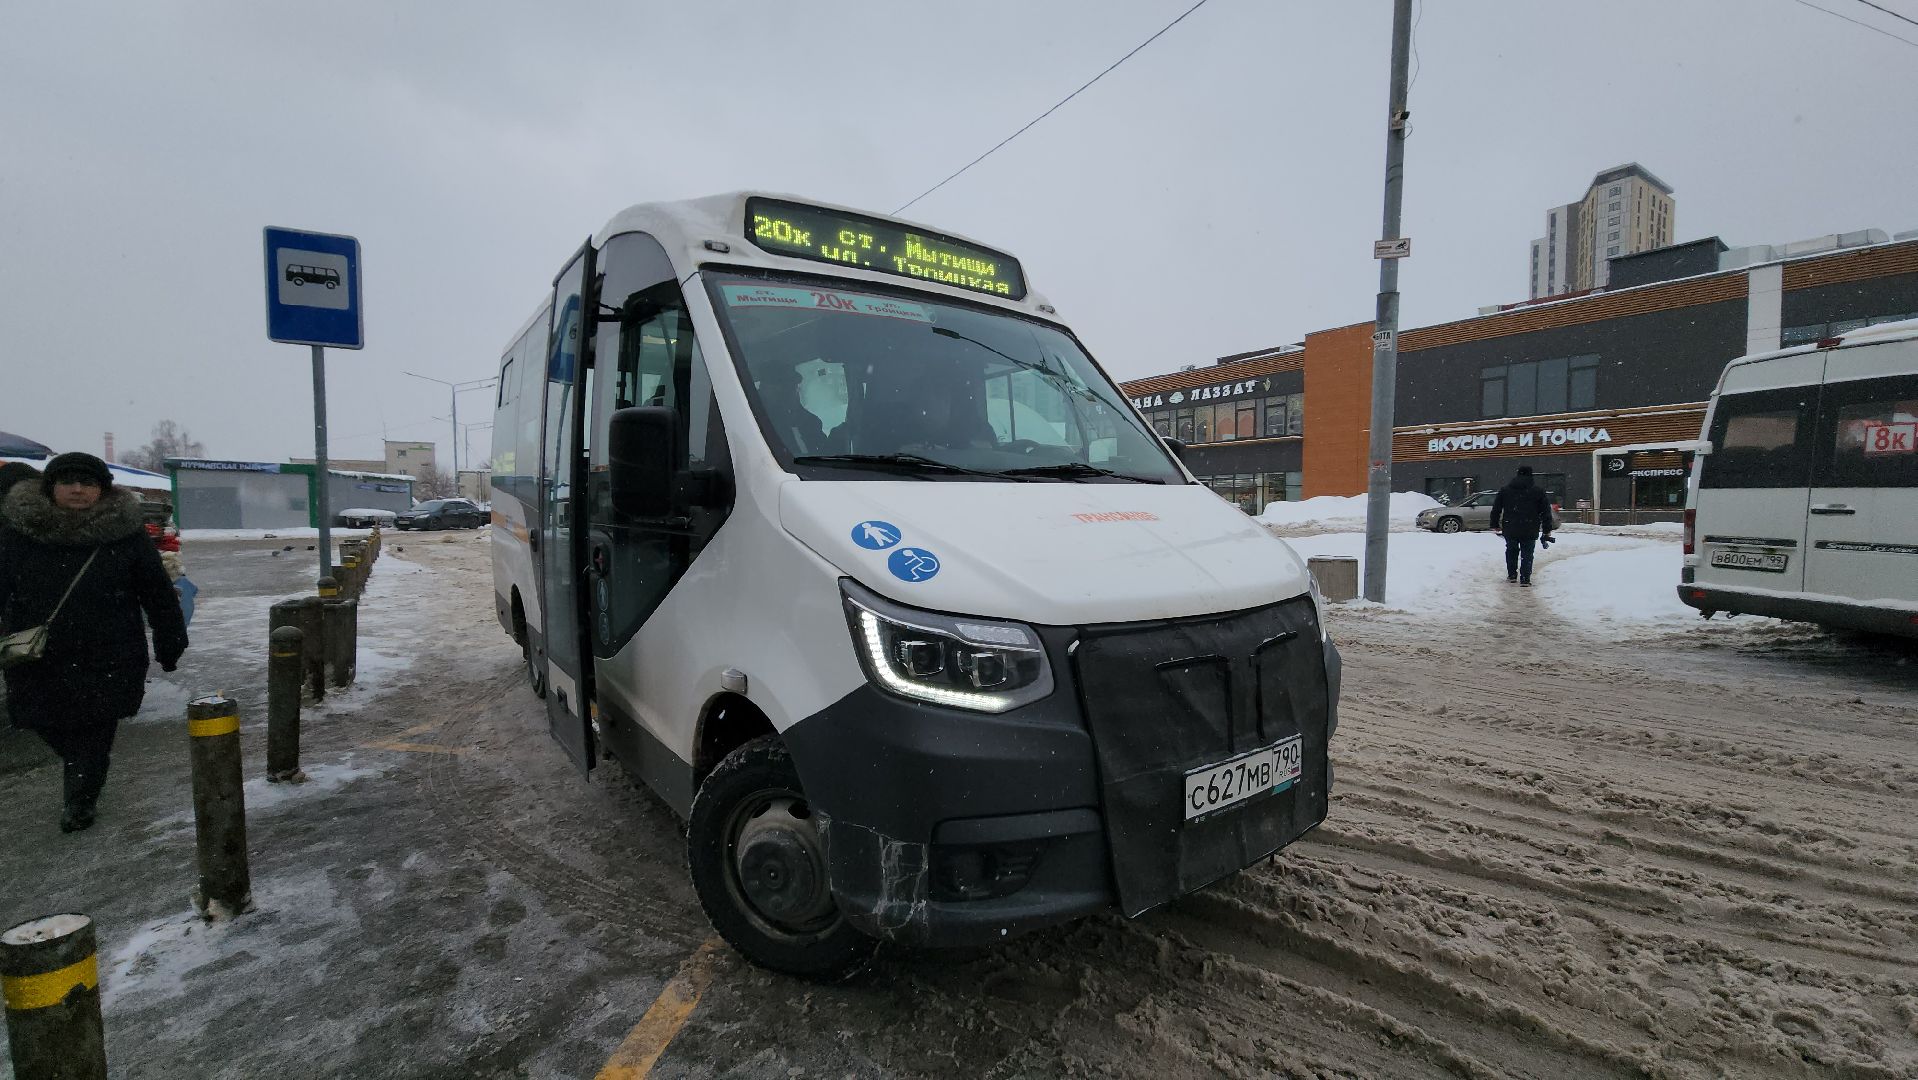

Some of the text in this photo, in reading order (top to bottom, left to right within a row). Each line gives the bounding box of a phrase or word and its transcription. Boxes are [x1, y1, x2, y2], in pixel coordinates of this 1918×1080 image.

[754, 215, 811, 247] 20к
[839, 230, 995, 276] ст. Мытищи
[1130, 379, 1259, 409] АНА ЛАЗЗАТ
[1428, 434, 1498, 452] ВКУСНО
[1519, 432, 1533, 447] И
[1538, 427, 1612, 446] ТОЧКА
[1273, 743, 1300, 773] 790
